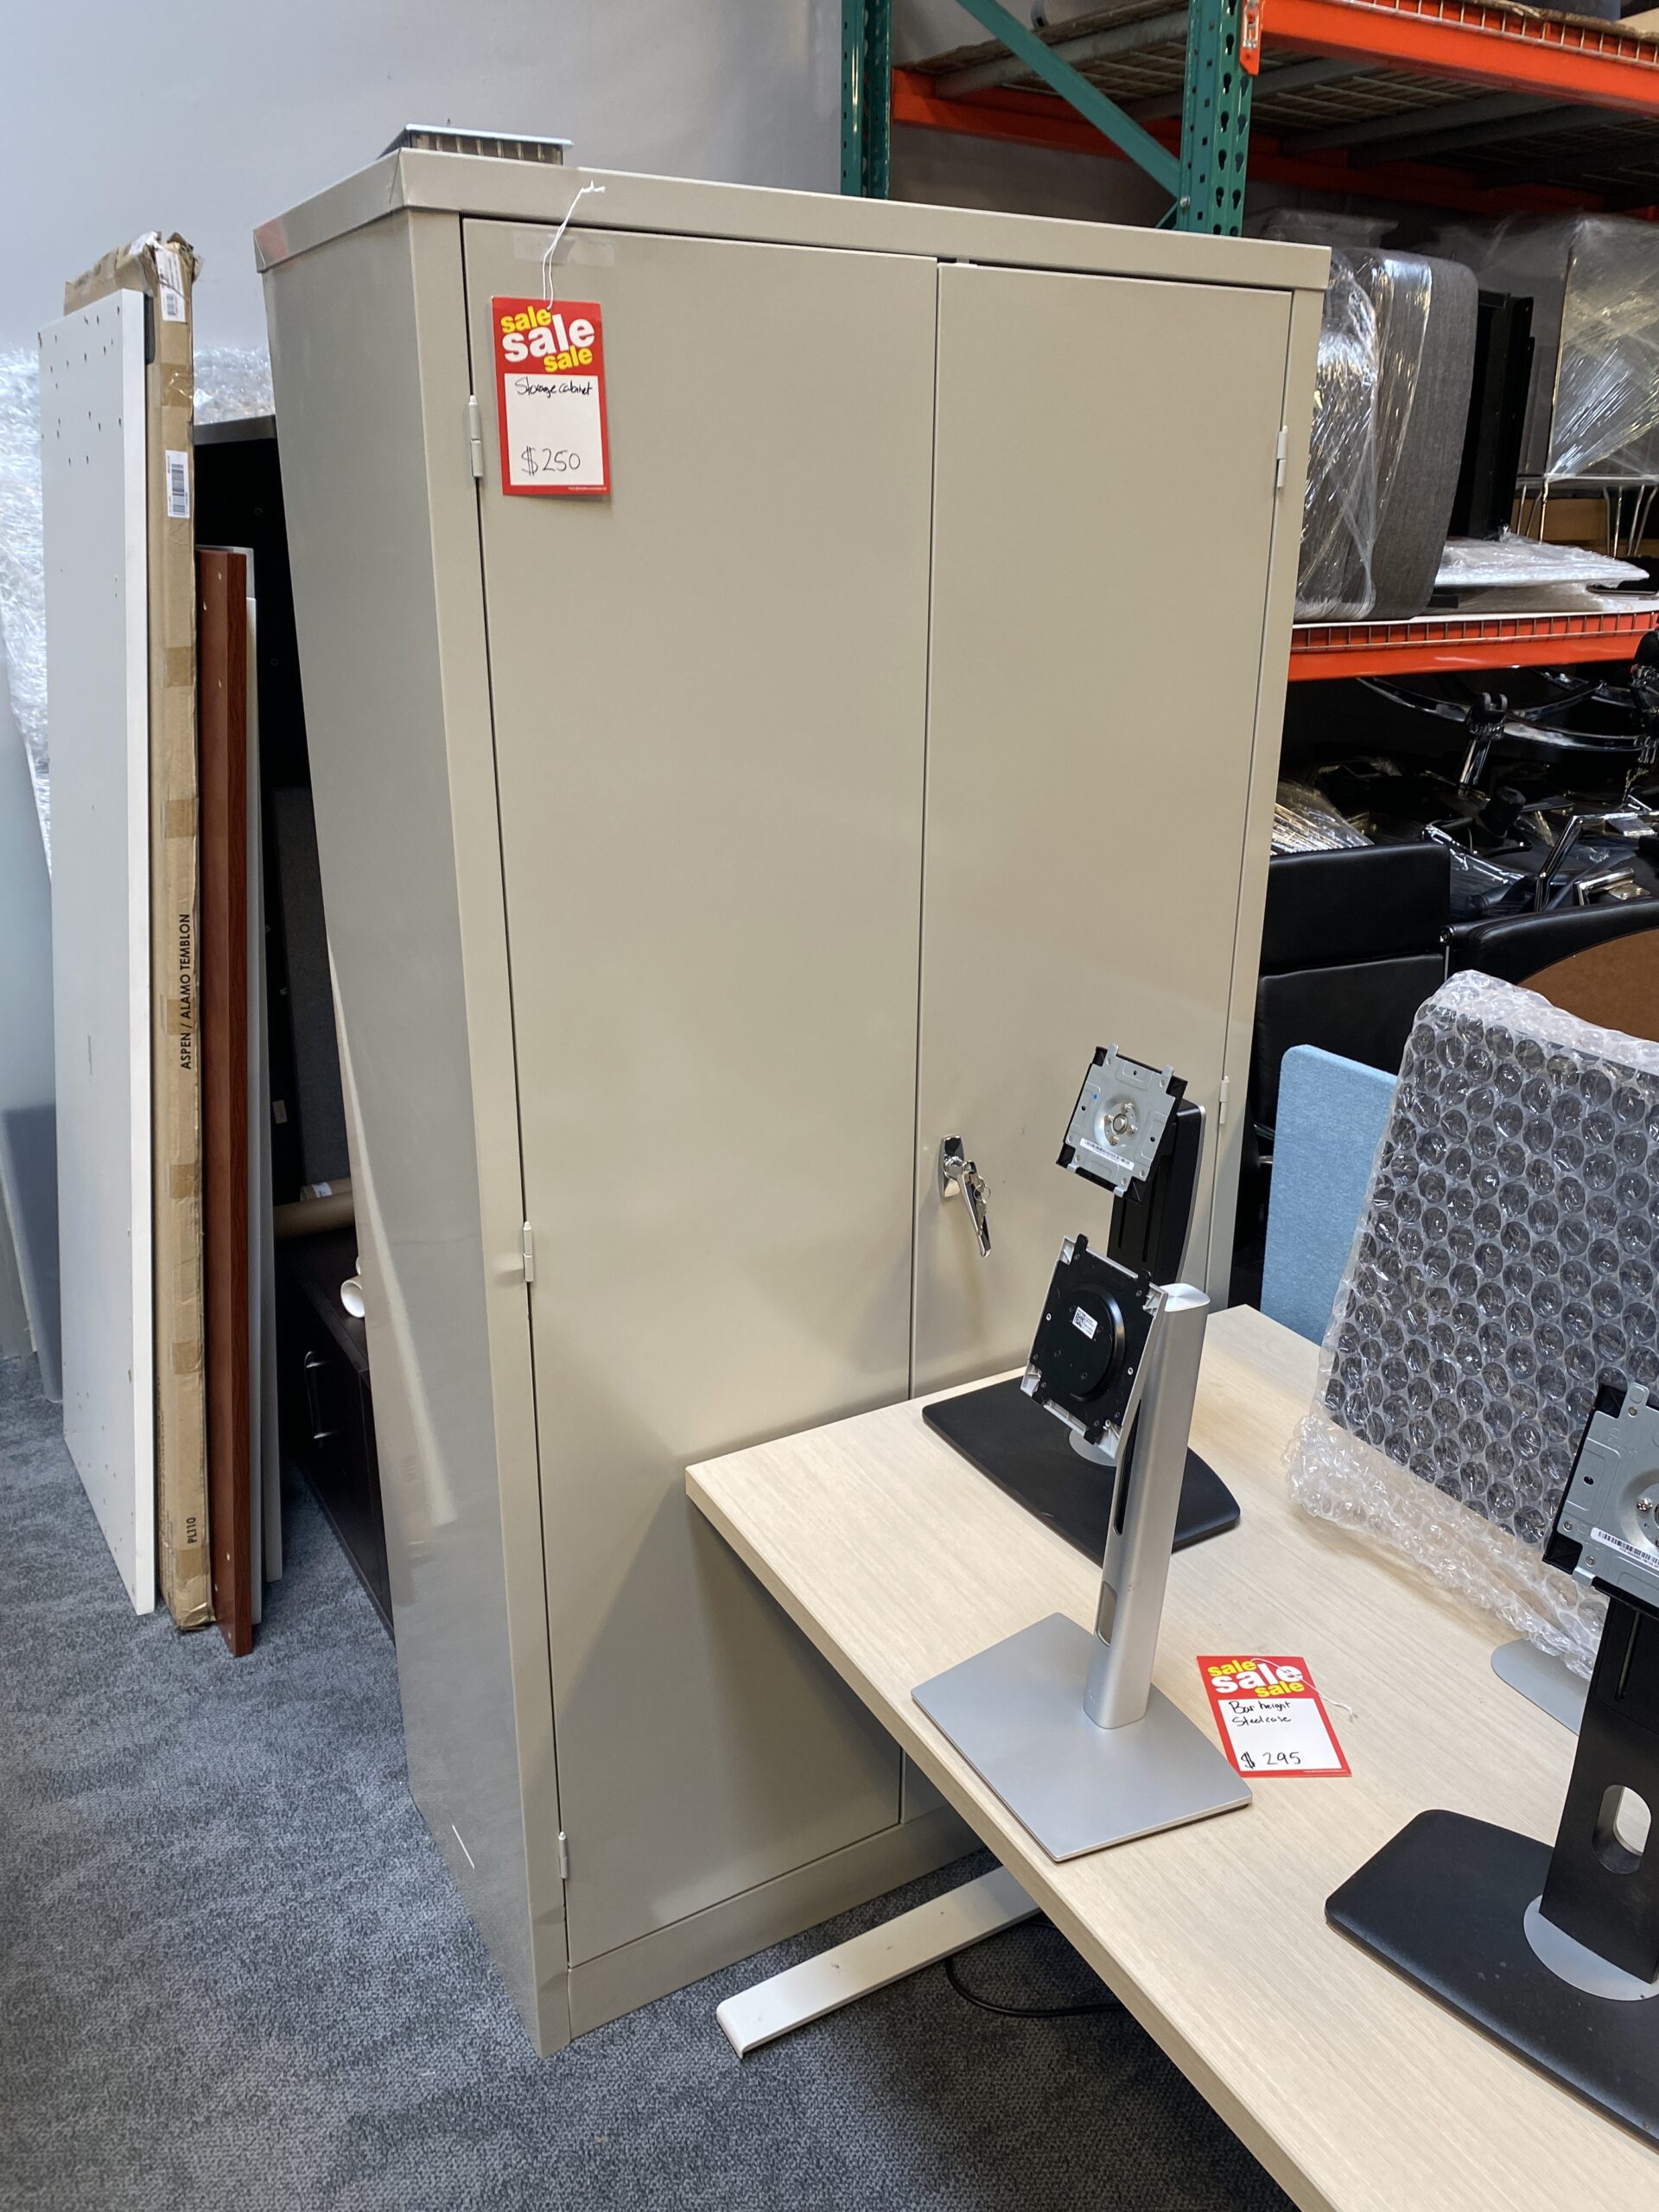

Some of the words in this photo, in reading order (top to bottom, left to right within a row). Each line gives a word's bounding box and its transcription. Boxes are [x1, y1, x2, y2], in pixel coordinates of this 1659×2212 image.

[501, 306, 551, 333] sale
[502, 314, 594, 362] sale
[543, 346, 593, 372] sale
[521, 446, 581, 476] $250
[179, 914, 190, 970] TEMBLON
[180, 974, 191, 1019] ALAMO
[181, 1033, 191, 1070] ASPEN
[1207, 1660, 1256, 1676] sale
[1211, 1663, 1303, 1694] sale
[1255, 1681, 1305, 1698] sale
[1229, 1700, 1255, 1714] Bar
[1257, 1700, 1291, 1712] height
[1262, 1751, 1301, 1765] 295
